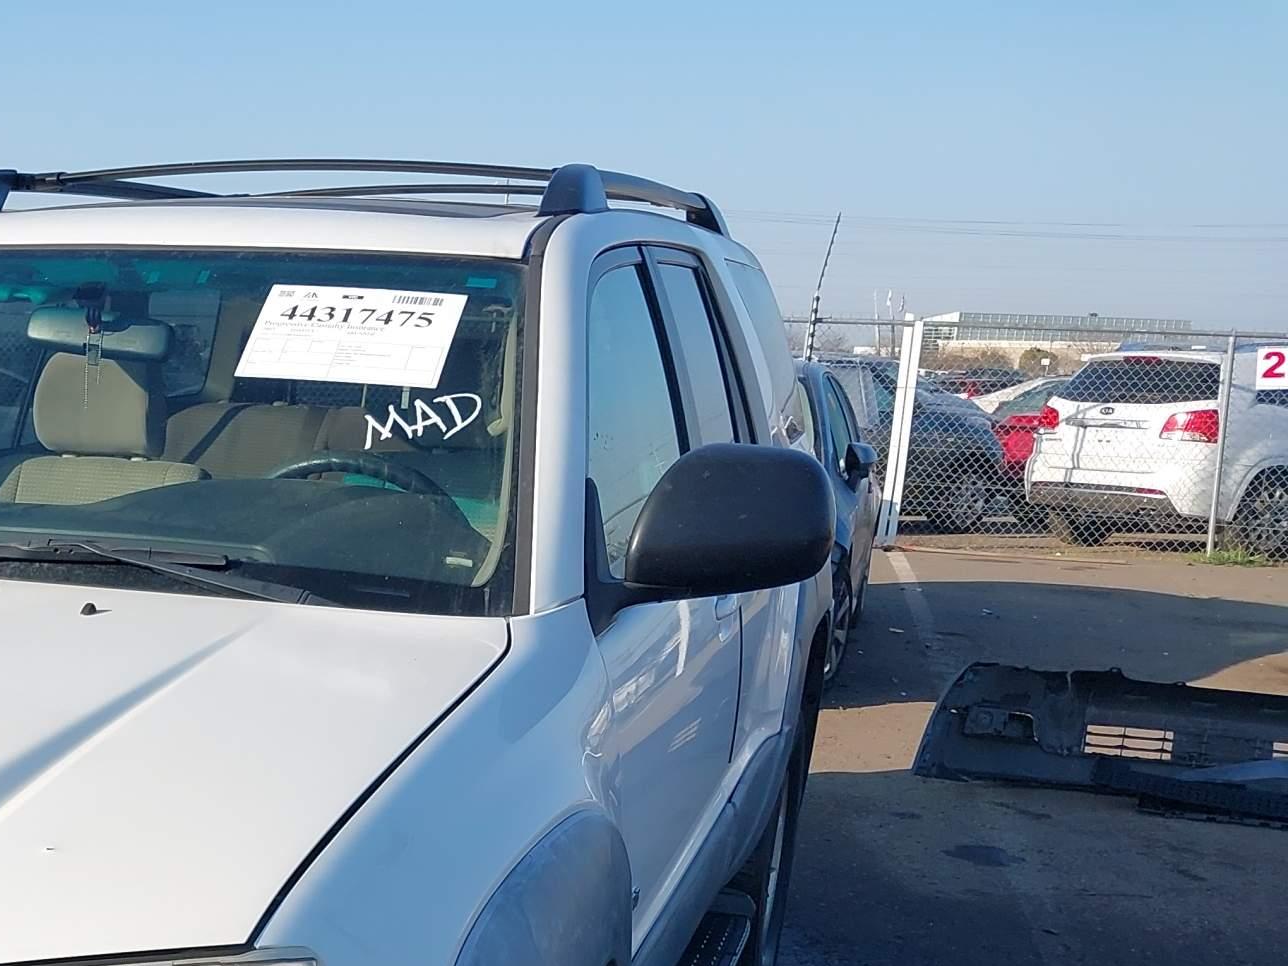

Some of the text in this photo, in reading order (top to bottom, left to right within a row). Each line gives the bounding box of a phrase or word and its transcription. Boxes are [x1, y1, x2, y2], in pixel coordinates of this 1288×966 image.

[279, 304, 435, 328] 44317475
[1262, 351, 1286, 378] 2
[363, 393, 482, 450] MAD
